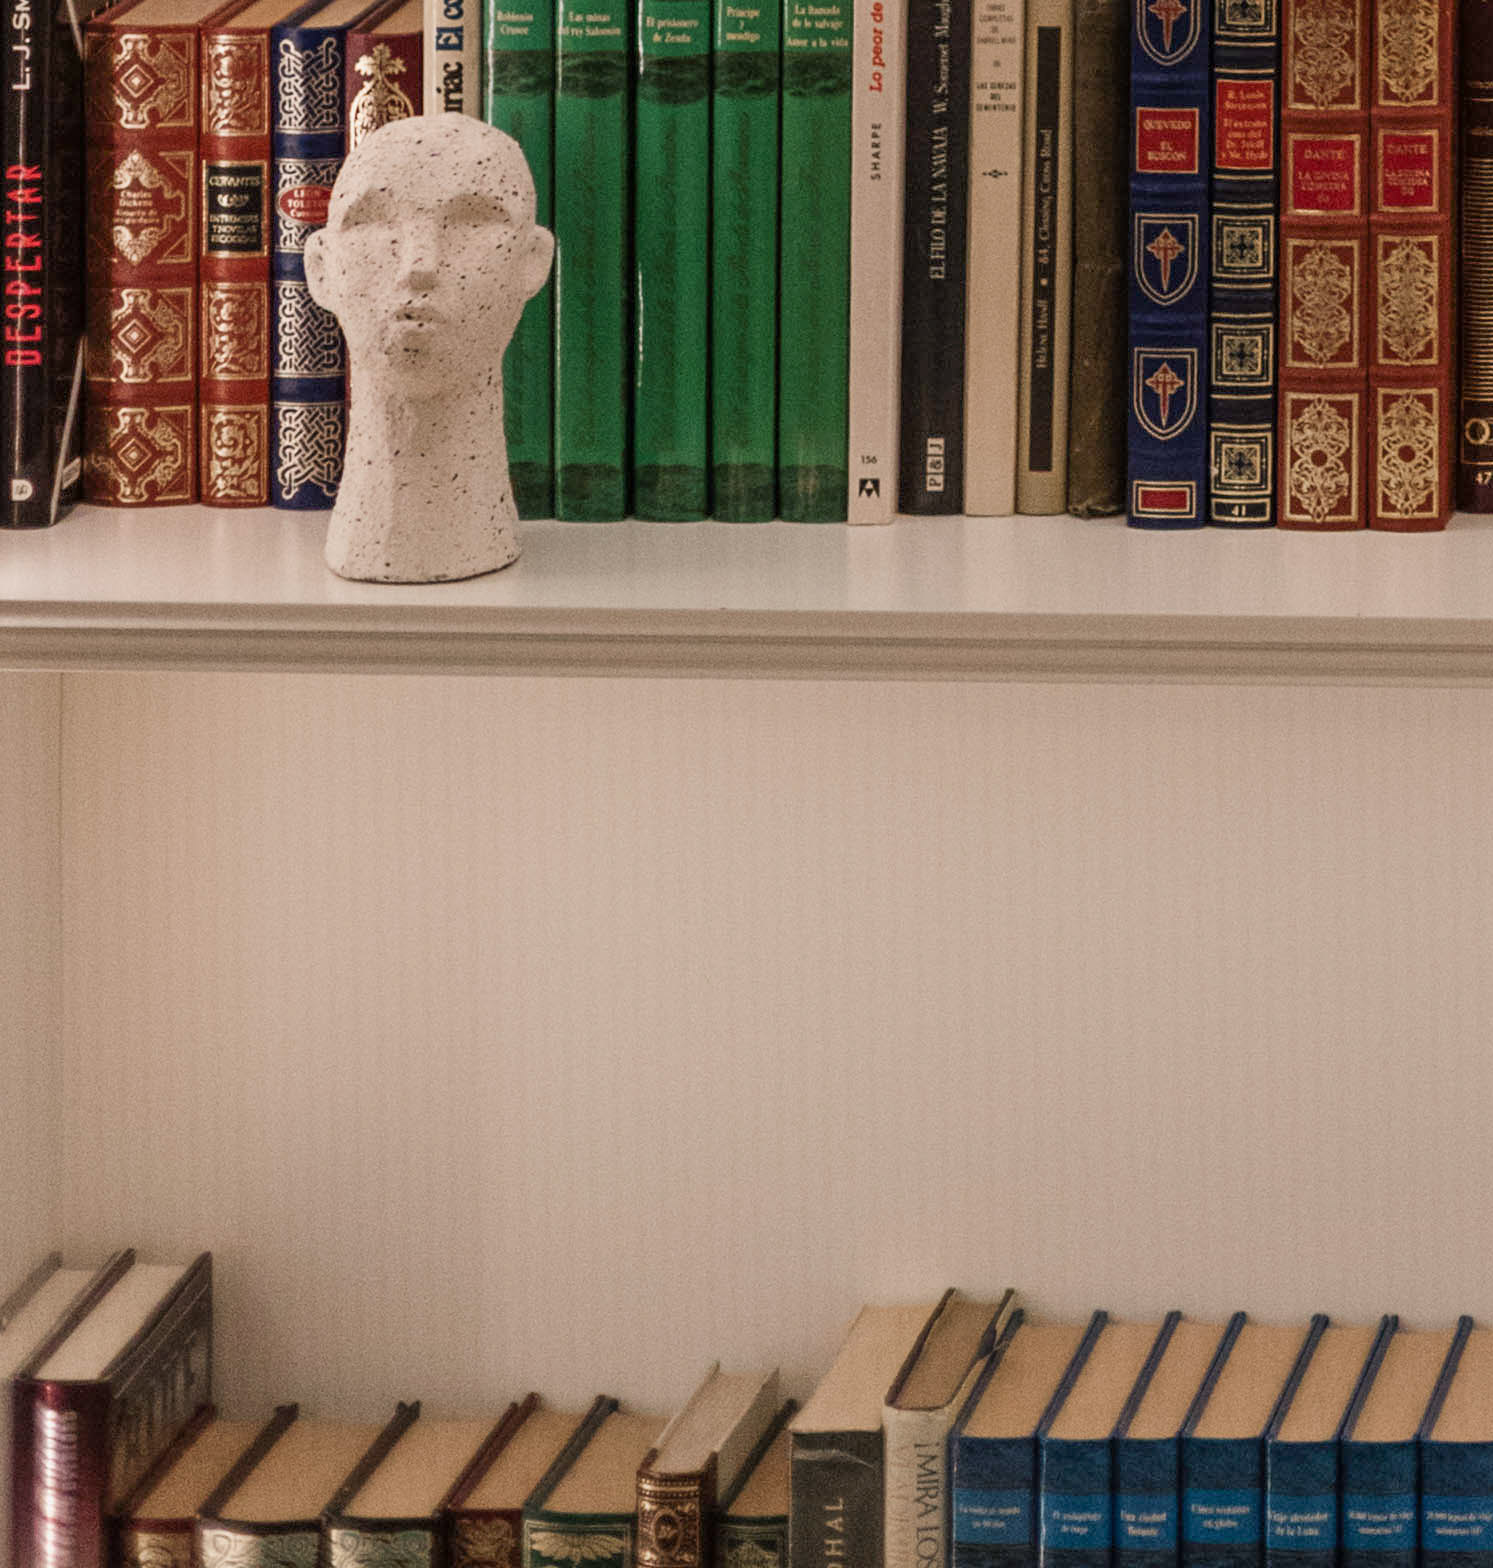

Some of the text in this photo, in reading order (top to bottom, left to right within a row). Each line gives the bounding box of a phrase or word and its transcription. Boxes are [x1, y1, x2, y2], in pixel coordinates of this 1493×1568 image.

[871, 3, 884, 23] de
[436, 27, 464, 51] El
[872, 28, 885, 67] peor
[869, 72, 882, 93] Lo
[5, 164, 43, 366] DESPERTAR
